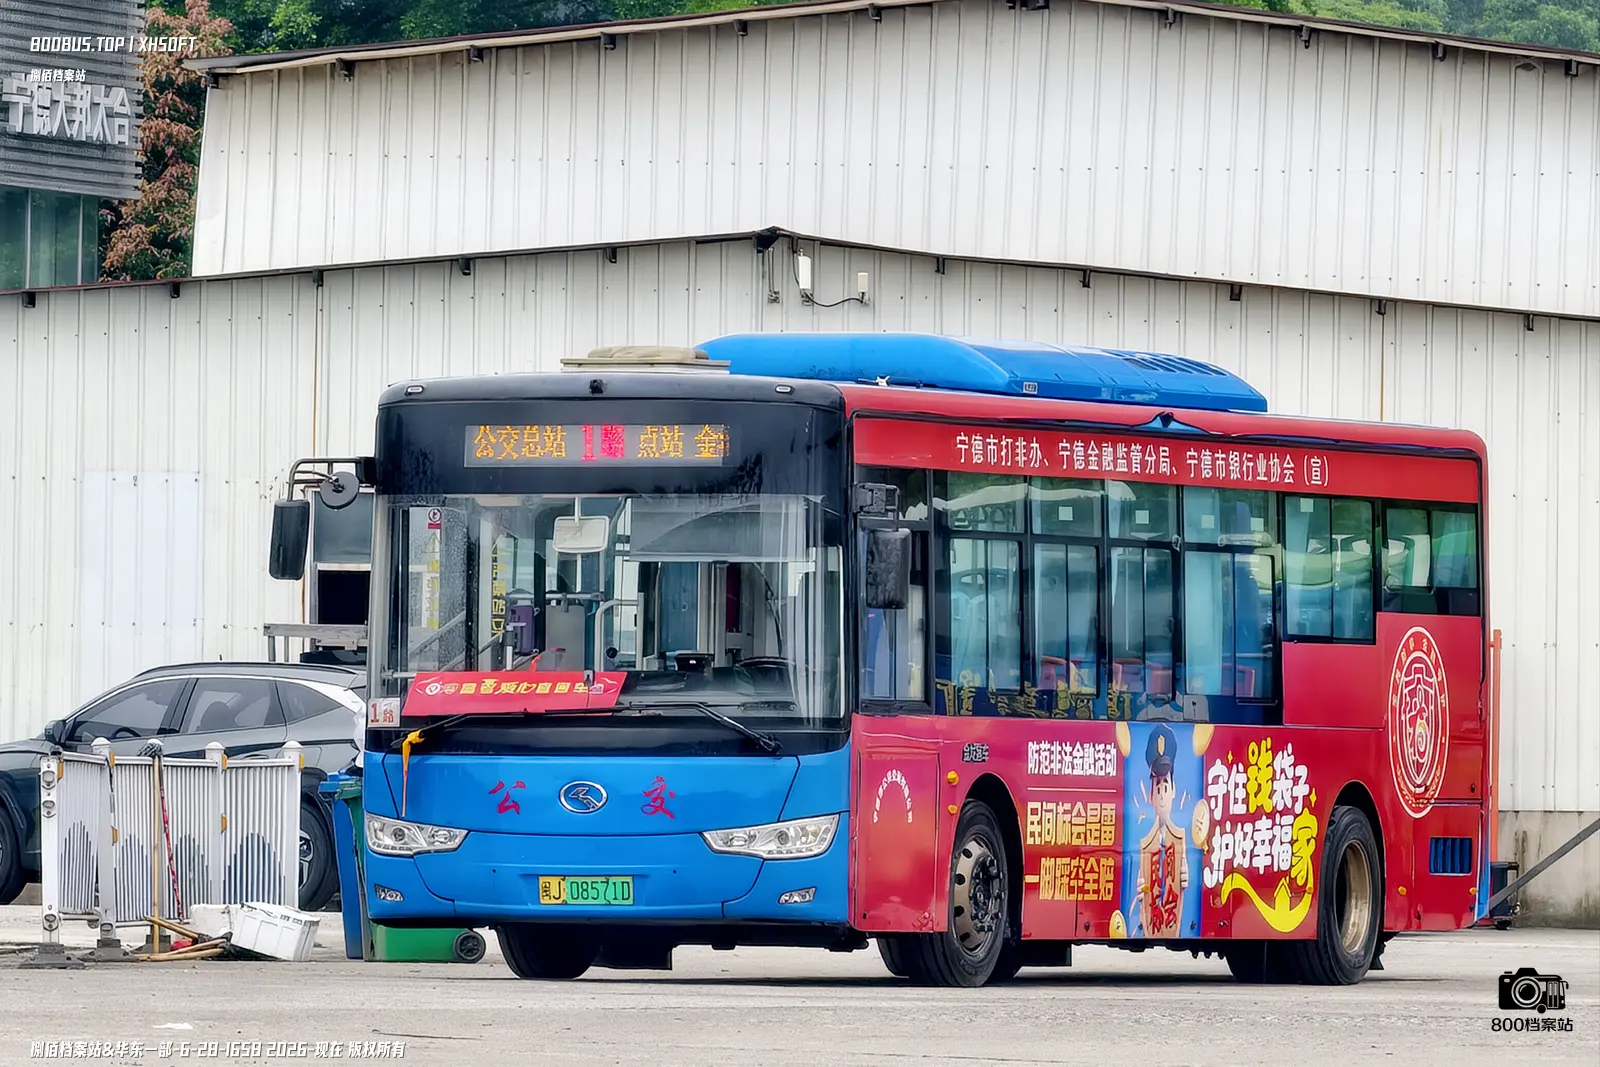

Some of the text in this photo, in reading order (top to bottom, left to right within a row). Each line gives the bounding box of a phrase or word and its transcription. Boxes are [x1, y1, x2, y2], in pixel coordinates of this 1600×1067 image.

[473, 424, 567, 460] 公交总站
[1027, 741, 1117, 777] 防范非法金融活动
[1207, 737, 1310, 821] 守住钱袋子
[489, 775, 676, 819] 公 交
[1203, 807, 1318, 888] 护好幸福家
[1024, 856, 1115, 901] 一脚踩空全赔
